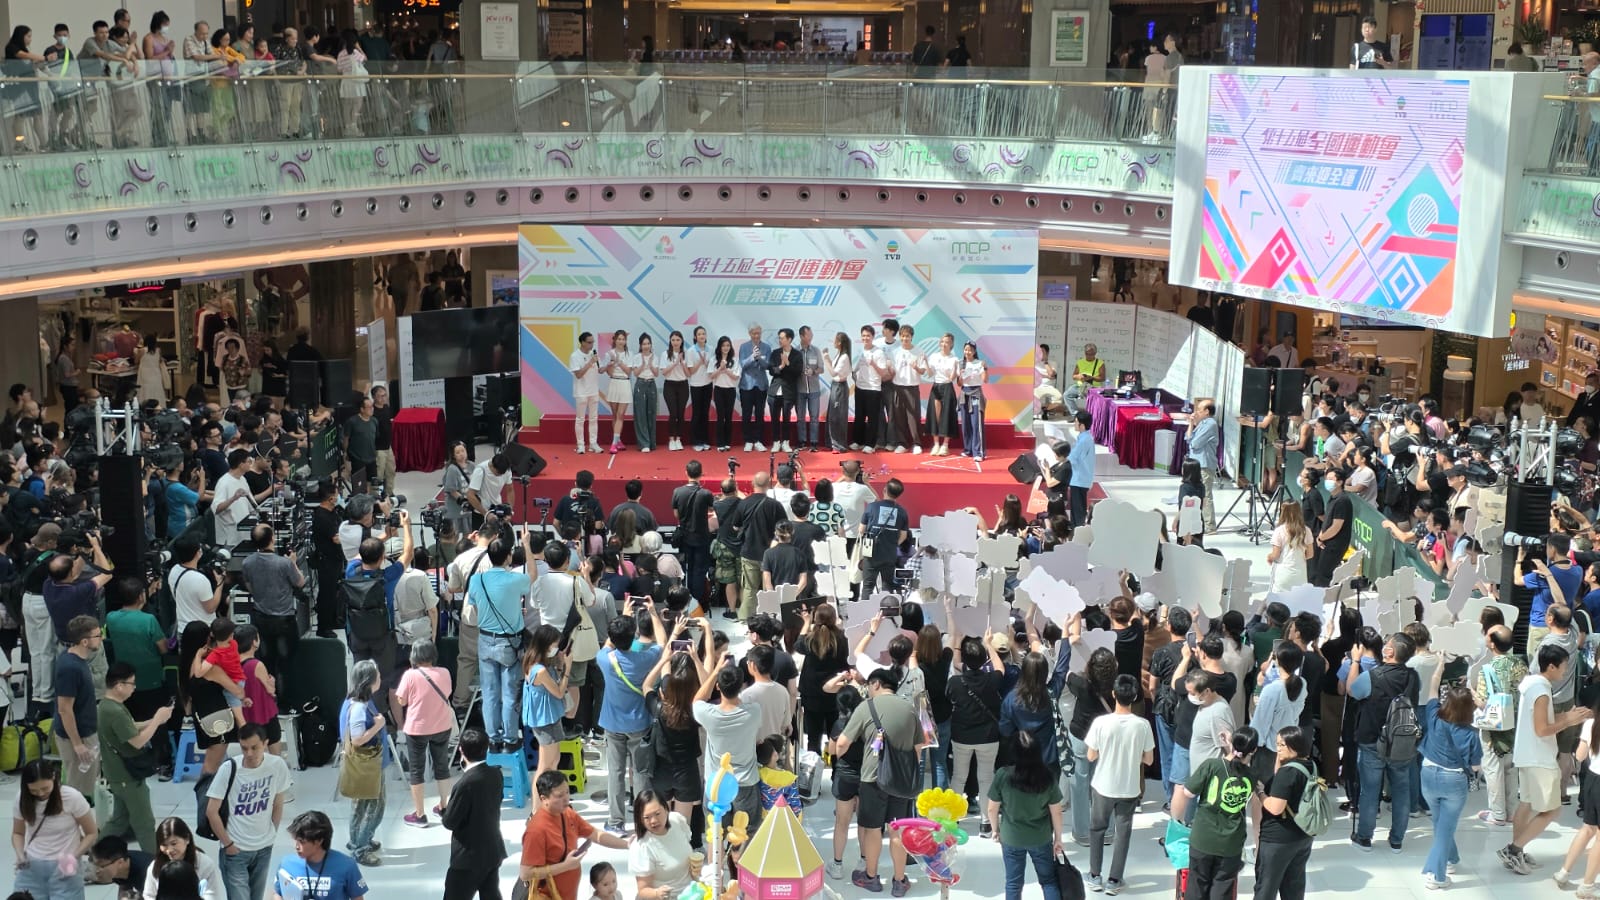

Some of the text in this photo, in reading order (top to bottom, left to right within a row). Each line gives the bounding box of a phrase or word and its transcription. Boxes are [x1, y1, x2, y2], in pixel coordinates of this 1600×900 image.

[952, 241, 991, 254] MCP
[1353, 517, 1373, 543] MCP
[240, 775, 273, 792] SHUT
[237, 787, 270, 803] UP &
[234, 798, 269, 816] RUN
